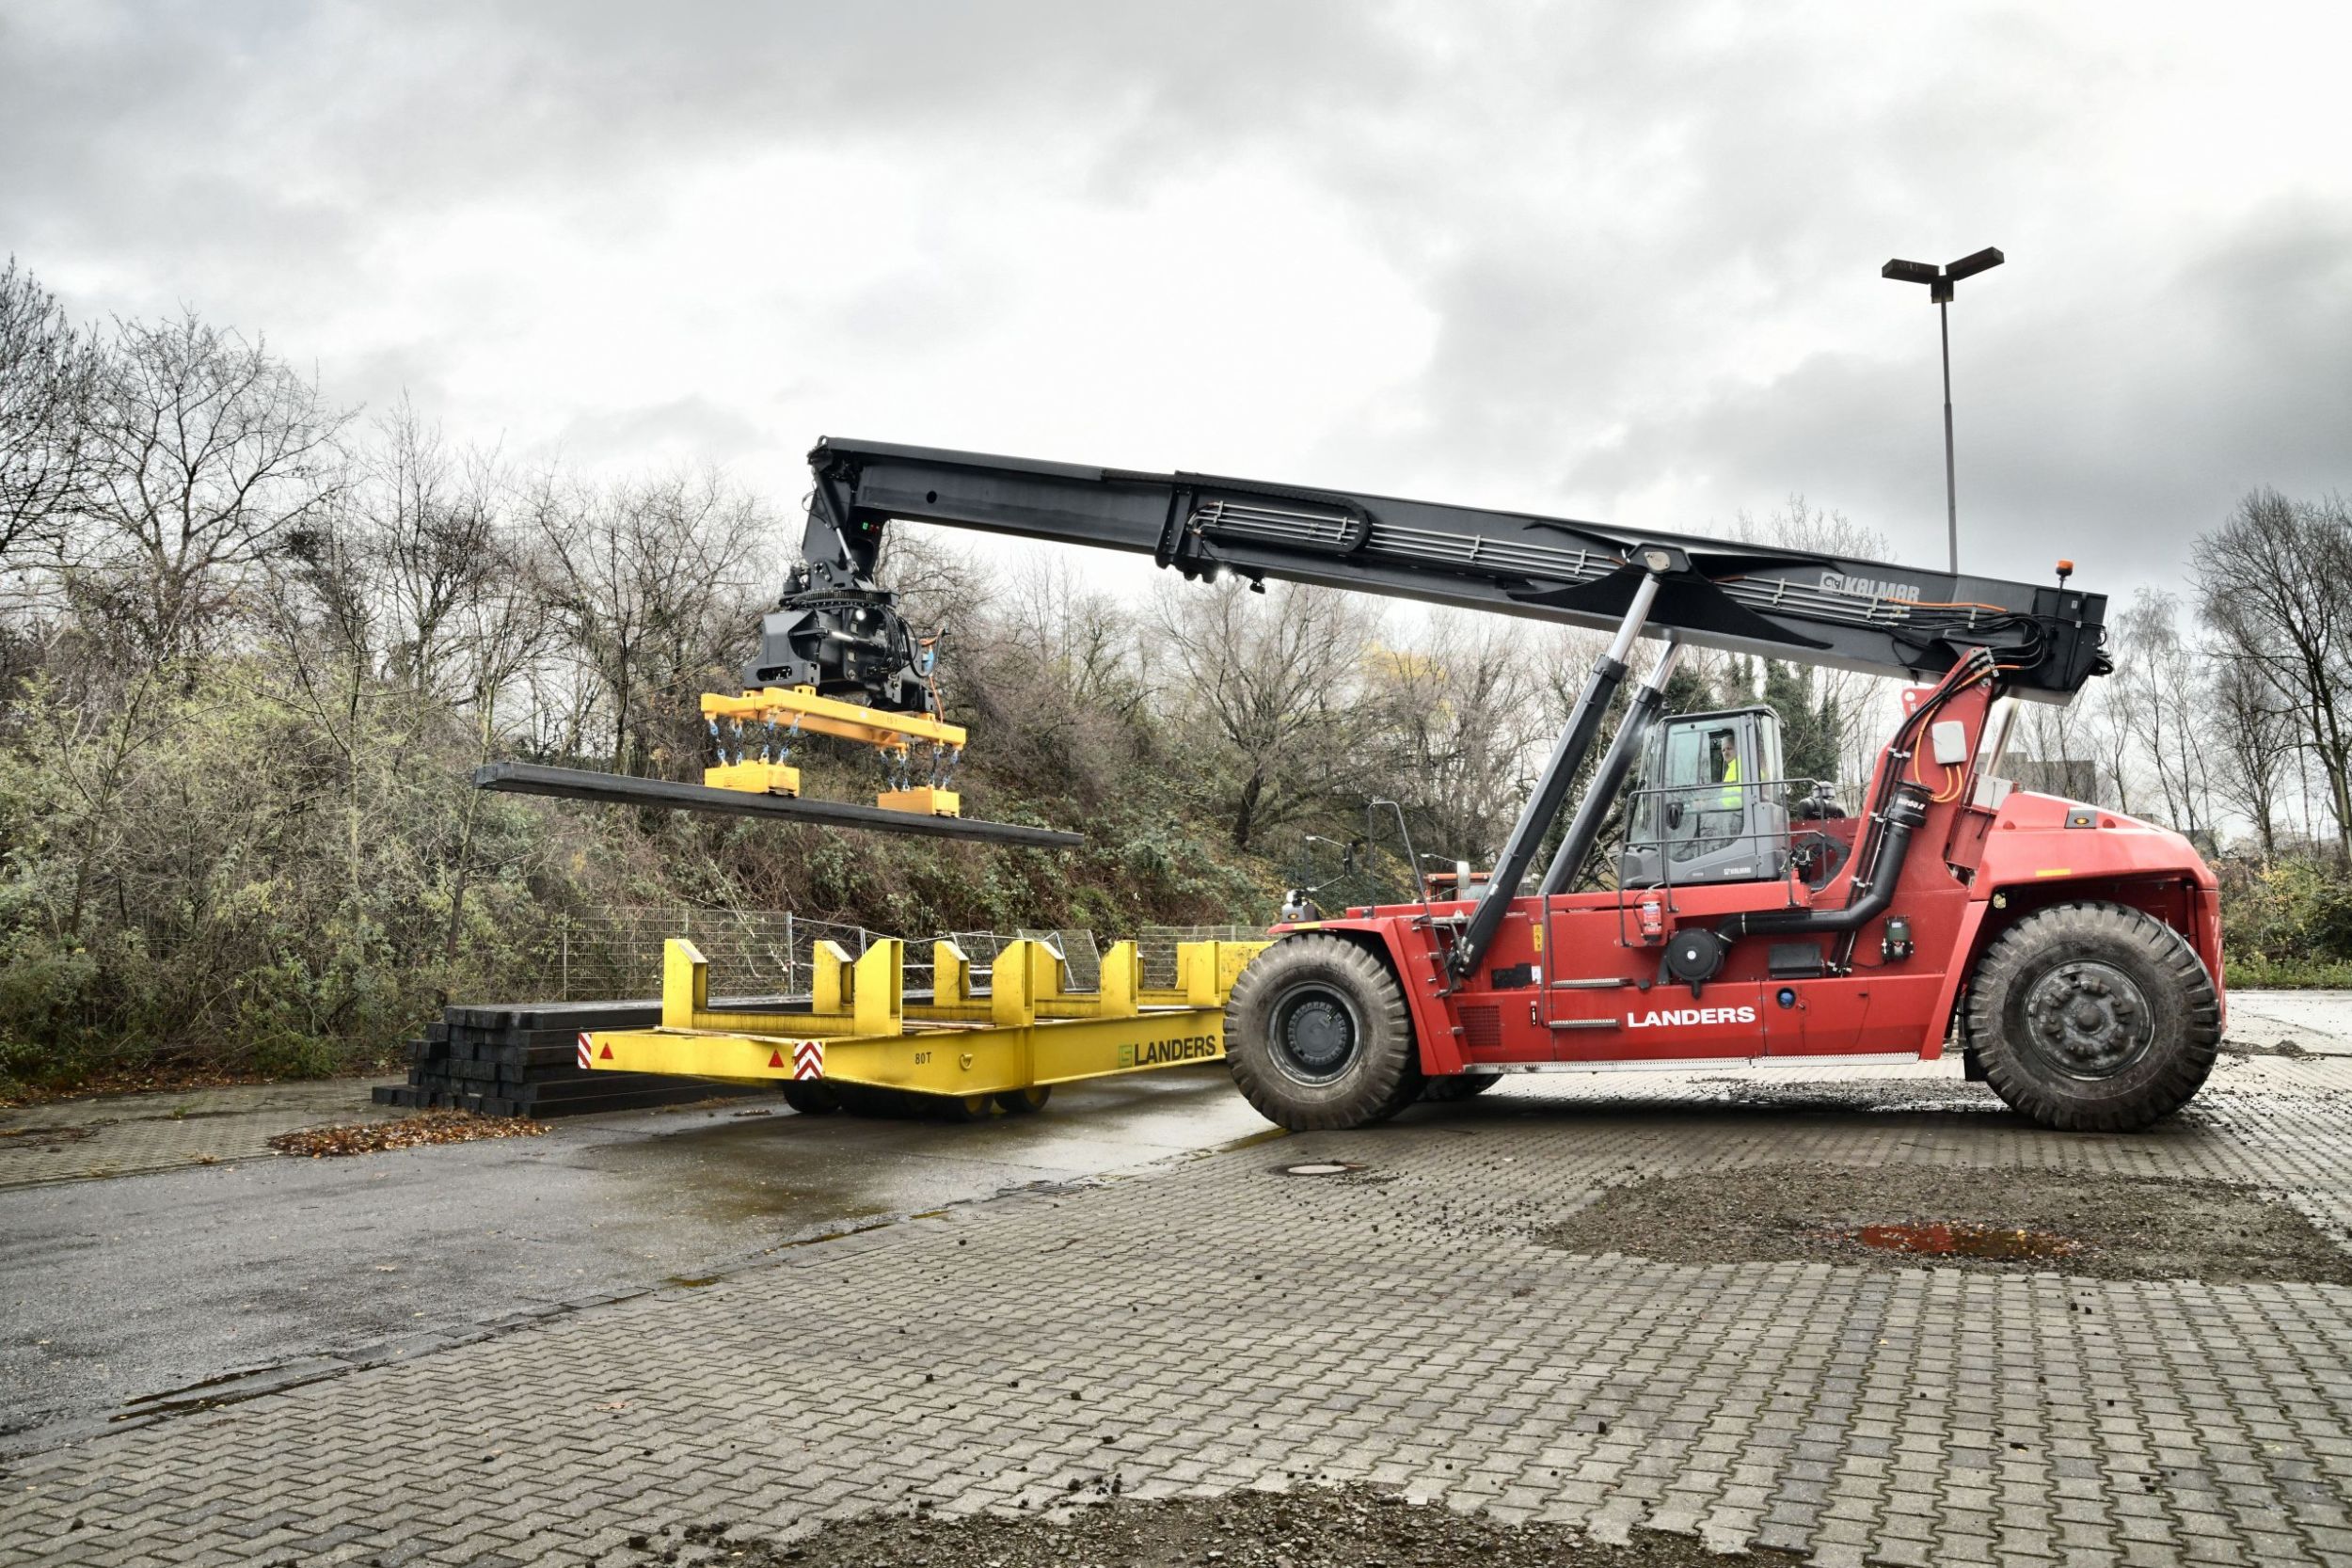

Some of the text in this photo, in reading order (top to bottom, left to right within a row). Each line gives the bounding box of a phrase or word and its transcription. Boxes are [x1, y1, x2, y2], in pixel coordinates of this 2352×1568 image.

[1844, 576, 1920, 602] KALMAR
[1628, 1006, 1756, 1027] LANDERS
[914, 1052, 932, 1065] 80T
[1134, 1035, 1216, 1066] LANDERS
